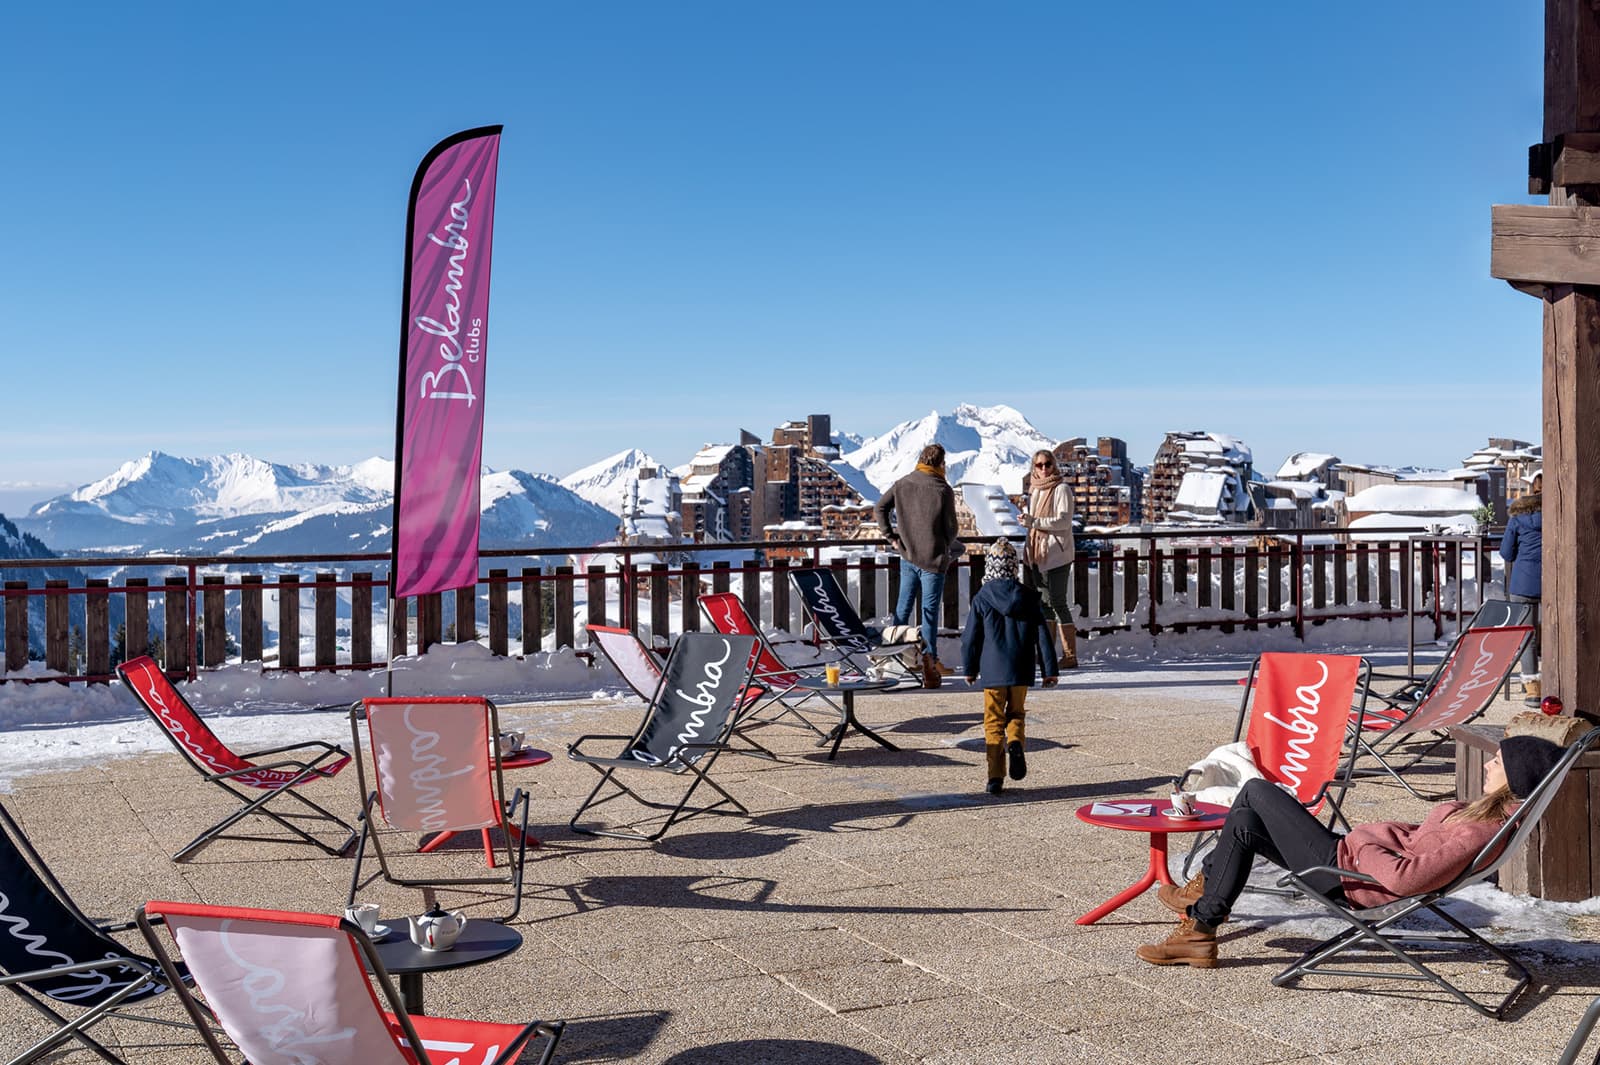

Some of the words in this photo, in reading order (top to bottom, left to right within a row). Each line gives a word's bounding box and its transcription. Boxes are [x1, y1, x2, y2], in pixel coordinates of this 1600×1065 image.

[415, 178, 477, 408] Belambra
[466, 317, 482, 363] clubs
[252, 768, 297, 782] club
